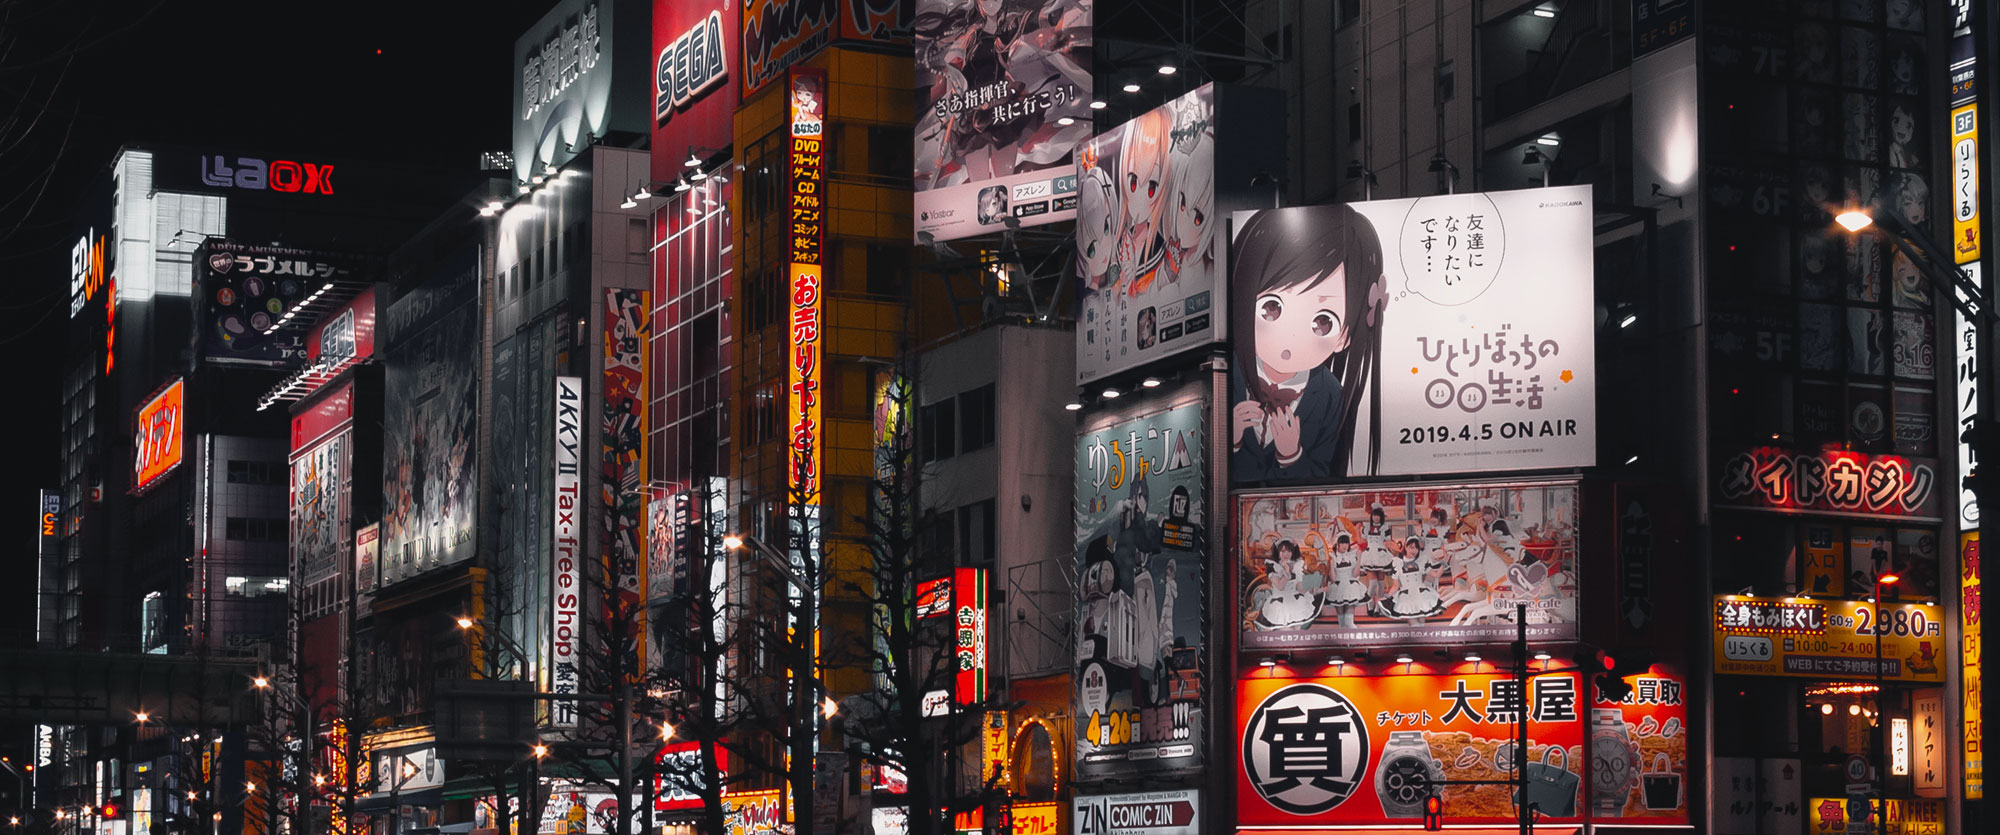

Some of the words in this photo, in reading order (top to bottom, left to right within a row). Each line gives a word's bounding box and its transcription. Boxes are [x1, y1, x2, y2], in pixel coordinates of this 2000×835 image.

[656, 10, 728, 120] SEGA
[793, 123, 821, 135] あなたの
[1958, 114, 1972, 132] 3F
[794, 139, 819, 153] DVD
[793, 154, 821, 167] ブルーレイ
[793, 167, 820, 181] ゲーム
[1960, 145, 1971, 218] りらくる
[797, 181, 815, 194] CD
[1015, 184, 1046, 198] アズレン
[793, 195, 819, 207] アイドル
[792, 209, 820, 221] アニメ
[793, 223, 818, 235] コミック
[794, 237, 817, 249] ホビー
[1444, 215, 1461, 286] なりたい
[1466, 213, 1485, 268] 友達に
[234, 255, 349, 278] ラブメルシー
[793, 251, 818, 263] フィギュア
[1161, 305, 1181, 320] アズレン
[321, 307, 356, 378] SEGA
[1417, 323, 1560, 378] ひとりぼっちの
[1893, 342, 1934, 368] 3.16
[559, 381, 578, 458] AKKY
[1399, 423, 1493, 444] 2019.4.5
[1500, 420, 1534, 440] ON
[1539, 419, 1577, 437] AIR
[1721, 453, 1934, 513] メイドカジノ
[557, 482, 578, 589] Tax-free
[1807, 553, 1836, 569] 入口
[1536, 597, 1561, 609] cafe
[555, 593, 577, 657] Shop
[1722, 604, 1821, 630] 全身もみほぐし
[1829, 614, 1853, 628] 60分
[957, 605, 974, 671] 吉野家
[1728, 641, 1768, 656] りらくる
[1787, 658, 1813, 671] WEB
[1440, 676, 1577, 725] 大黒屋
[1377, 710, 1432, 726] チケット
[1257, 703, 1356, 798] 質
[1895, 731, 1904, 772] ルノアール
[1925, 715, 1936, 783] ルノアール
[1850, 763, 1864, 775] 40
[1078, 798, 1107, 835] ZIN
[1111, 804, 1152, 828] COMIC
[1154, 803, 1173, 826] ZIN
[1851, 801, 1861, 818] P
[1908, 801, 1937, 822] FREE
